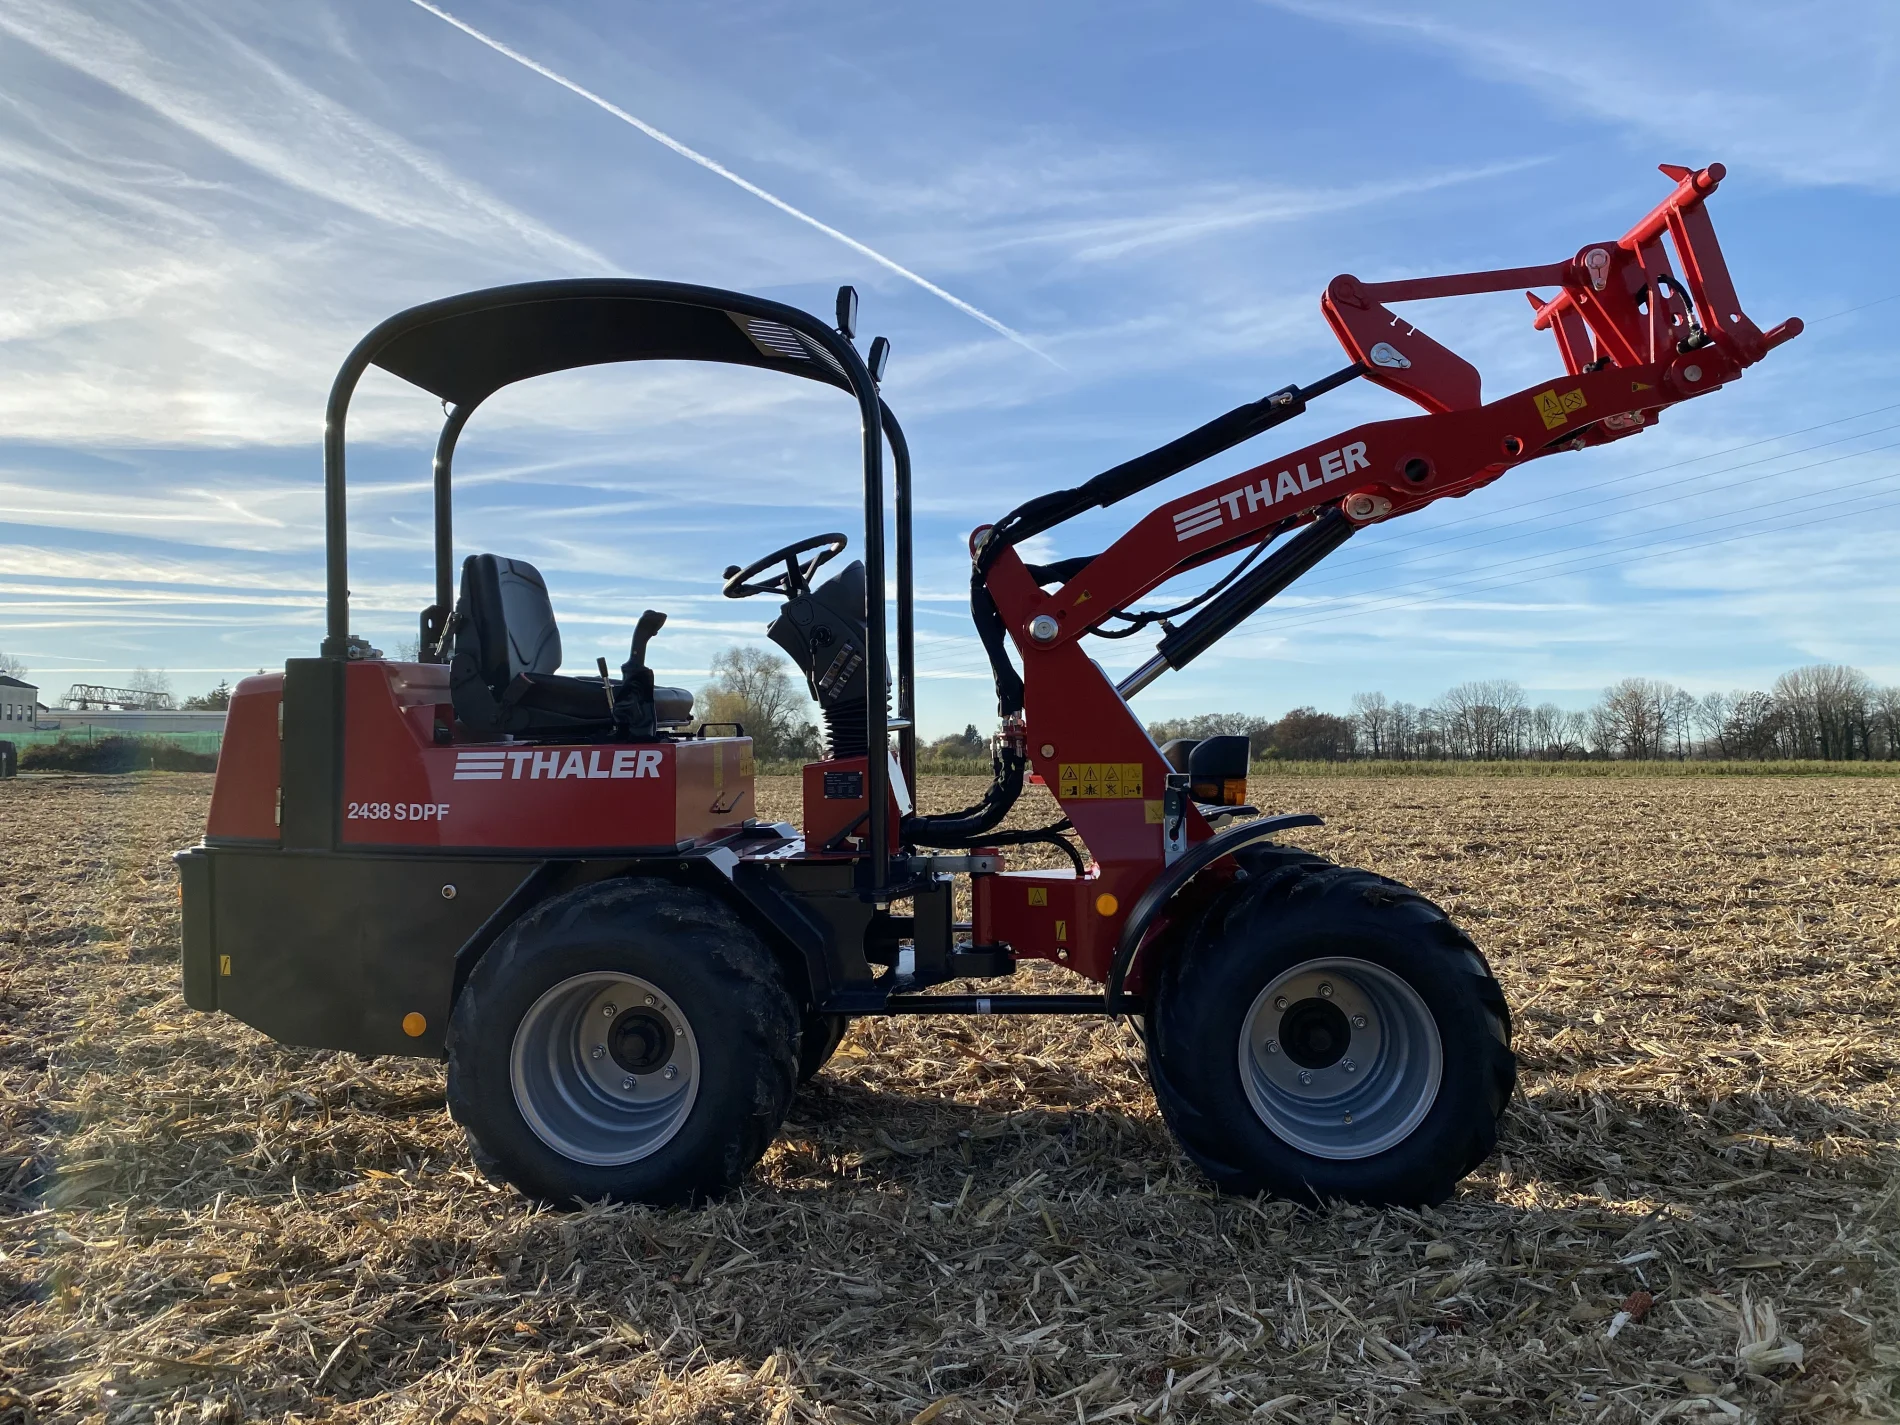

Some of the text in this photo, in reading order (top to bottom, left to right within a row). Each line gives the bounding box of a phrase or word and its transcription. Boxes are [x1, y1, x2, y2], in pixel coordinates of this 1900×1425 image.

[1219, 441, 1371, 521] THALER
[507, 750, 663, 780] THALER
[347, 802, 391, 820] 2438
